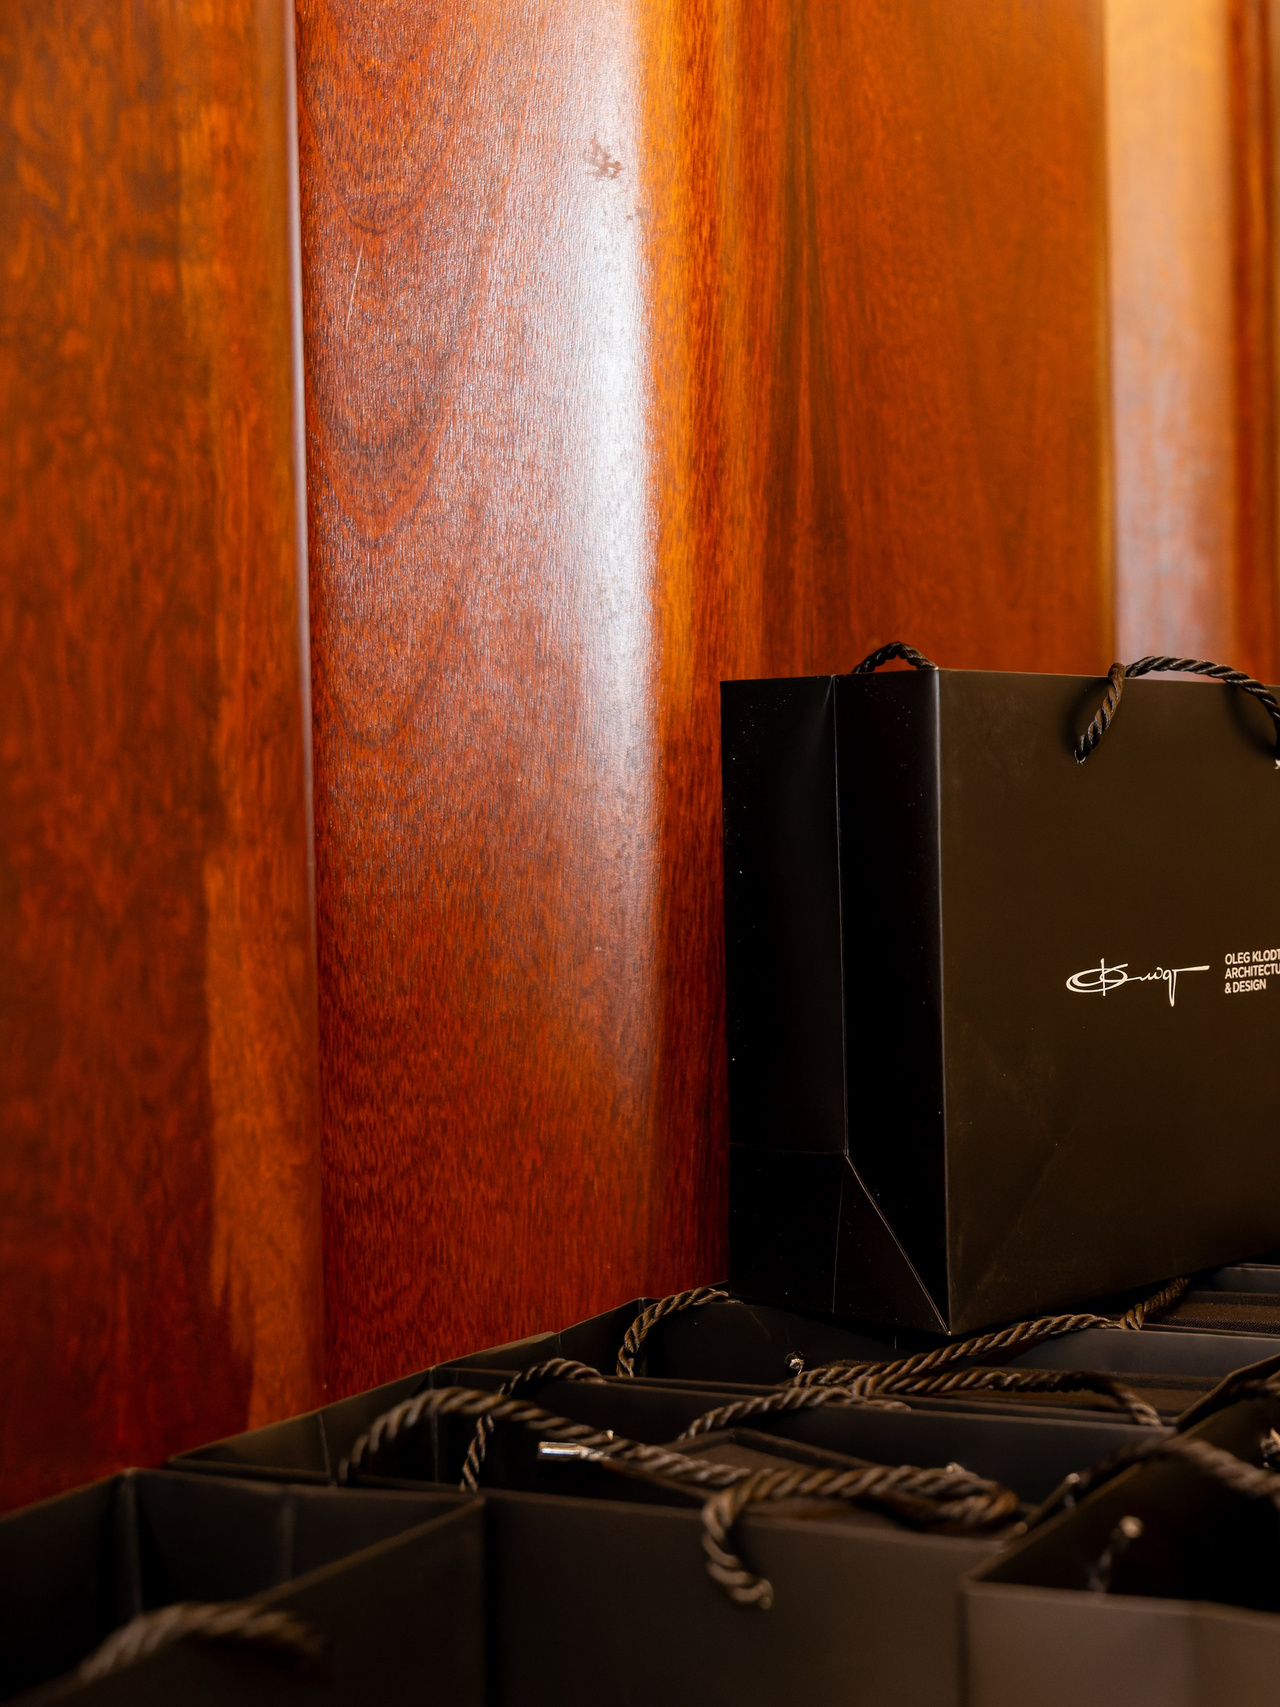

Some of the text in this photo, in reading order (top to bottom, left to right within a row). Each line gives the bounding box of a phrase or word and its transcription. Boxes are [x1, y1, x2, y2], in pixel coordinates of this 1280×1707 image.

[1225, 952, 1251, 965] OLEG
[1224, 978, 1267, 994] & DESIGN
